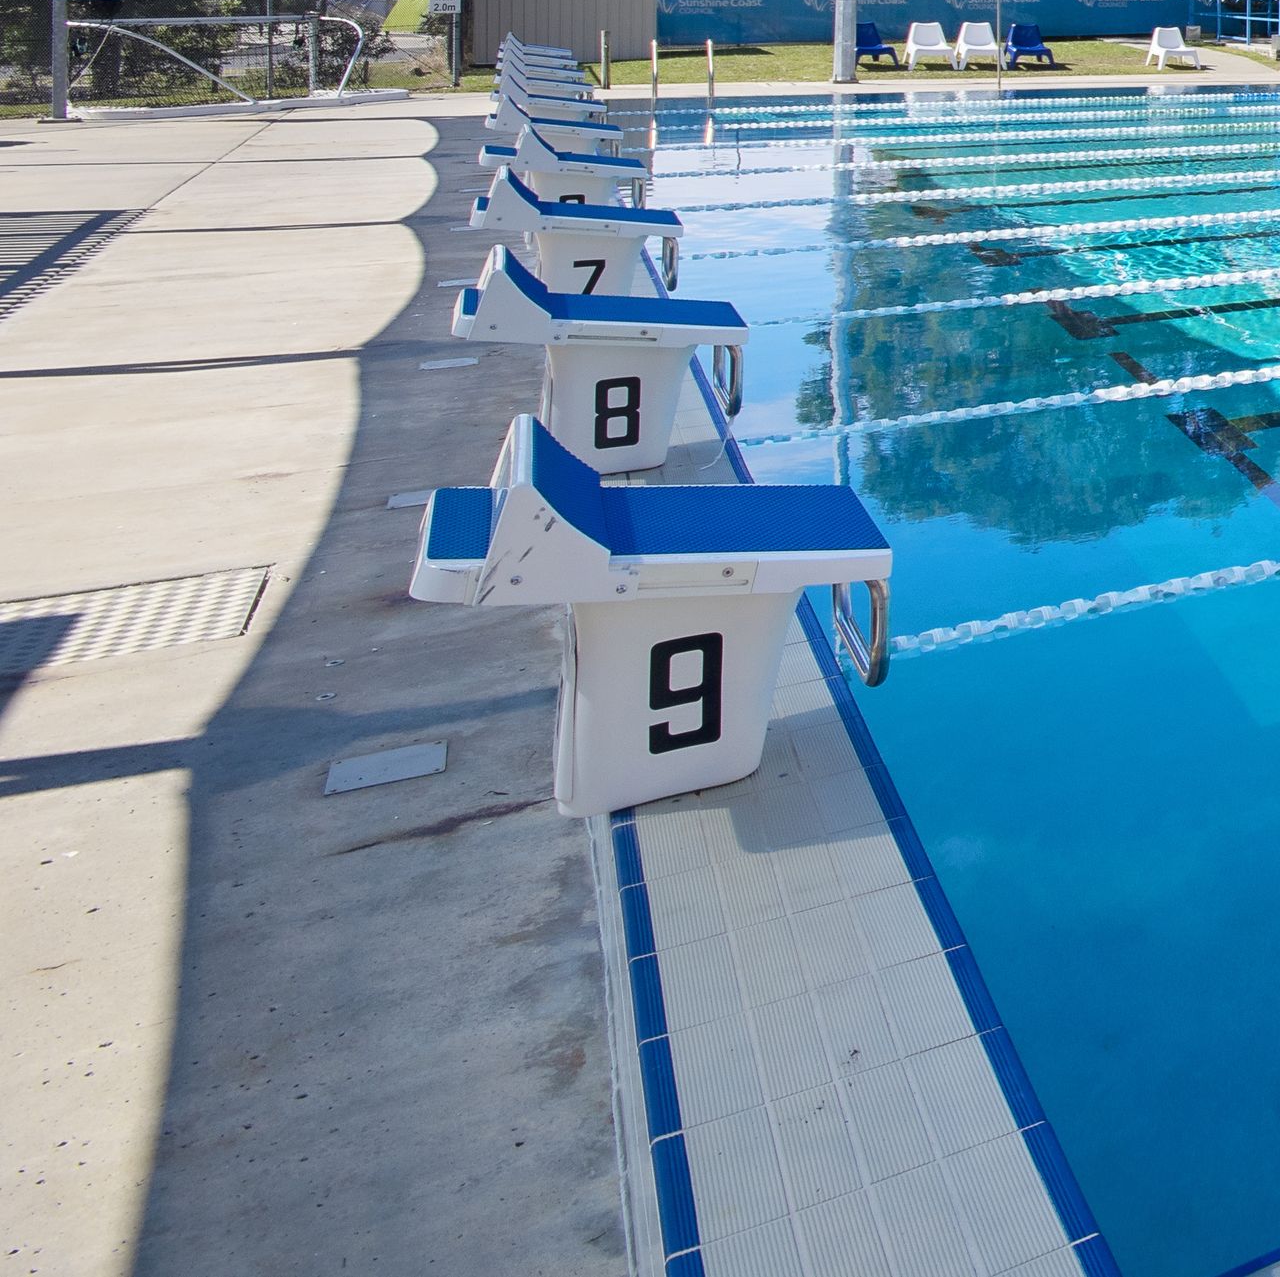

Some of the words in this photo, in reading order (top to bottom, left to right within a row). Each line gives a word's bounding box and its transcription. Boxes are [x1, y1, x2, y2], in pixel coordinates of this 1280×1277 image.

[433, 3, 456, 12] 2.0m
[573, 259, 606, 295] 7
[594, 376, 641, 450] 8
[649, 632, 724, 755] 9
